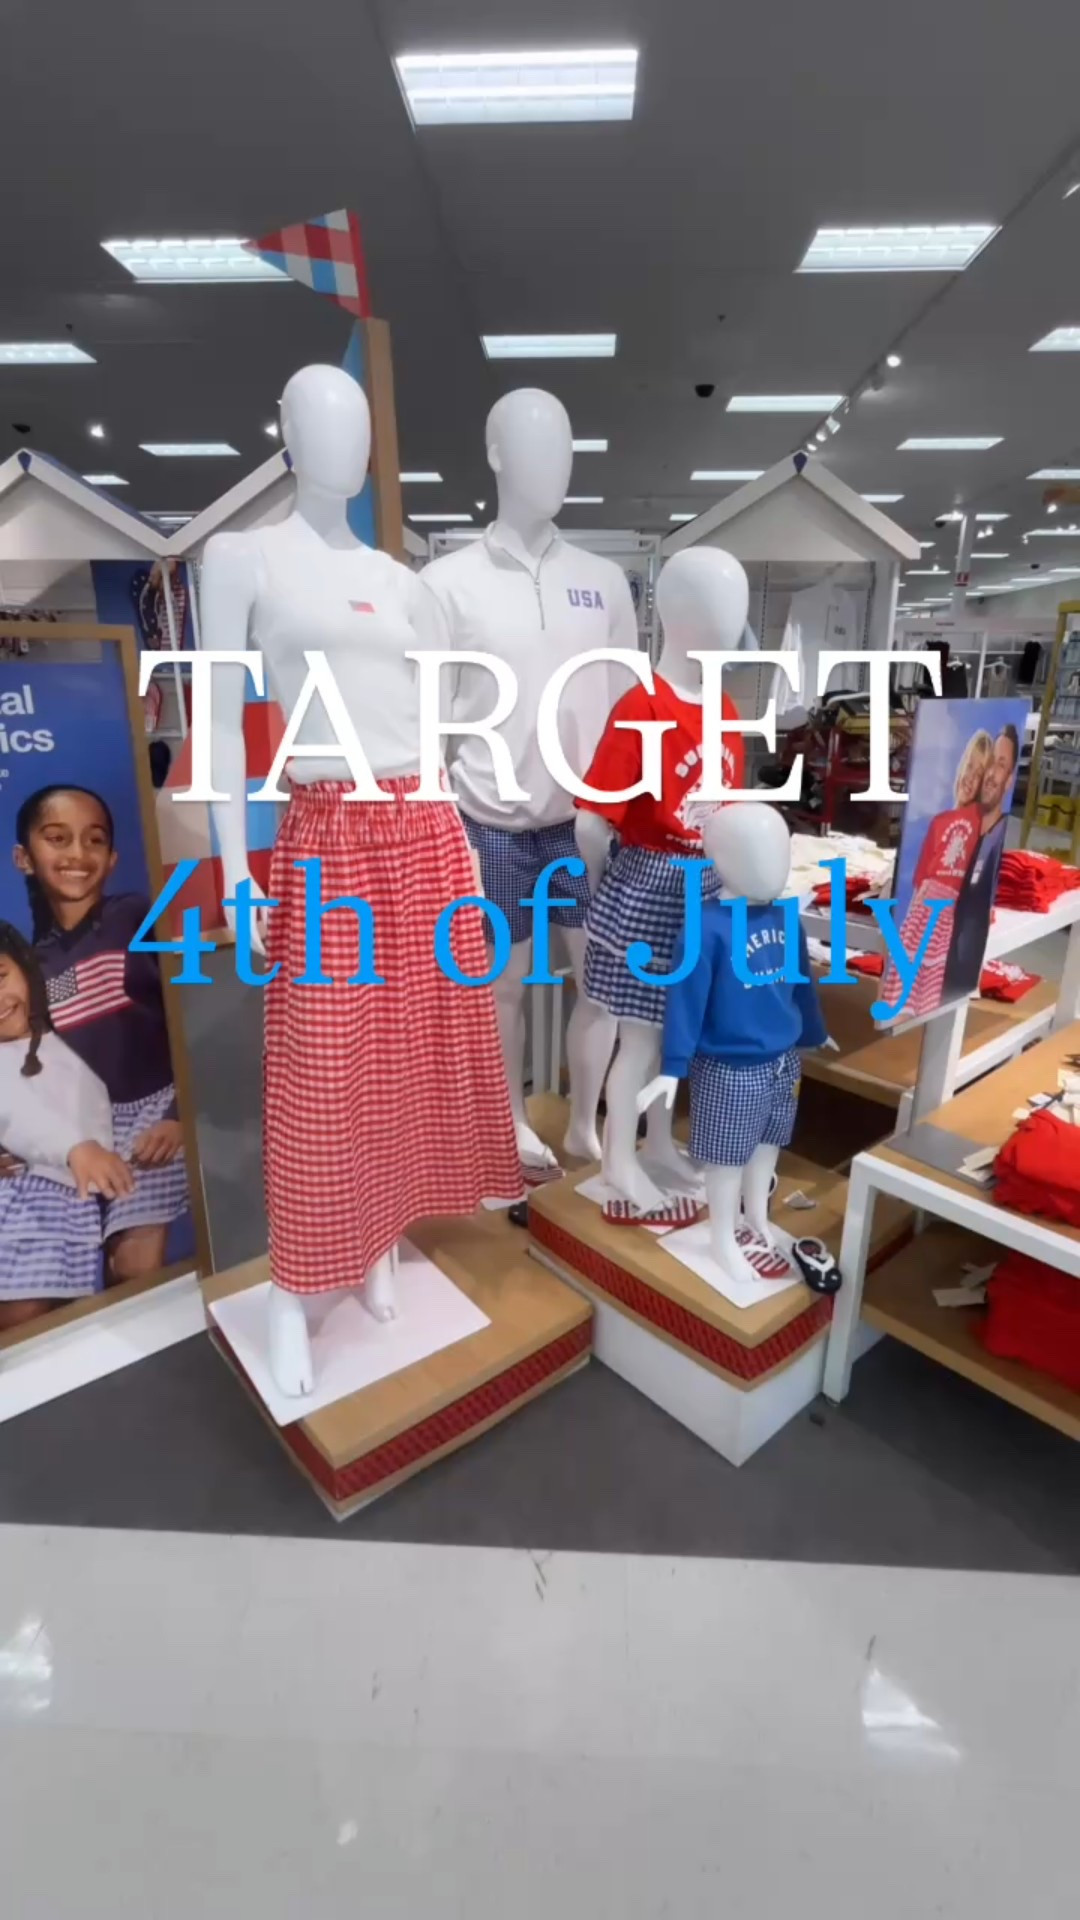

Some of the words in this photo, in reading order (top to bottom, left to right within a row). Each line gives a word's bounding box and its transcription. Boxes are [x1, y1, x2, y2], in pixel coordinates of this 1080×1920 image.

[567, 588, 604, 610] USA
[0, 684, 35, 716] al
[0, 723, 55, 753] ics
